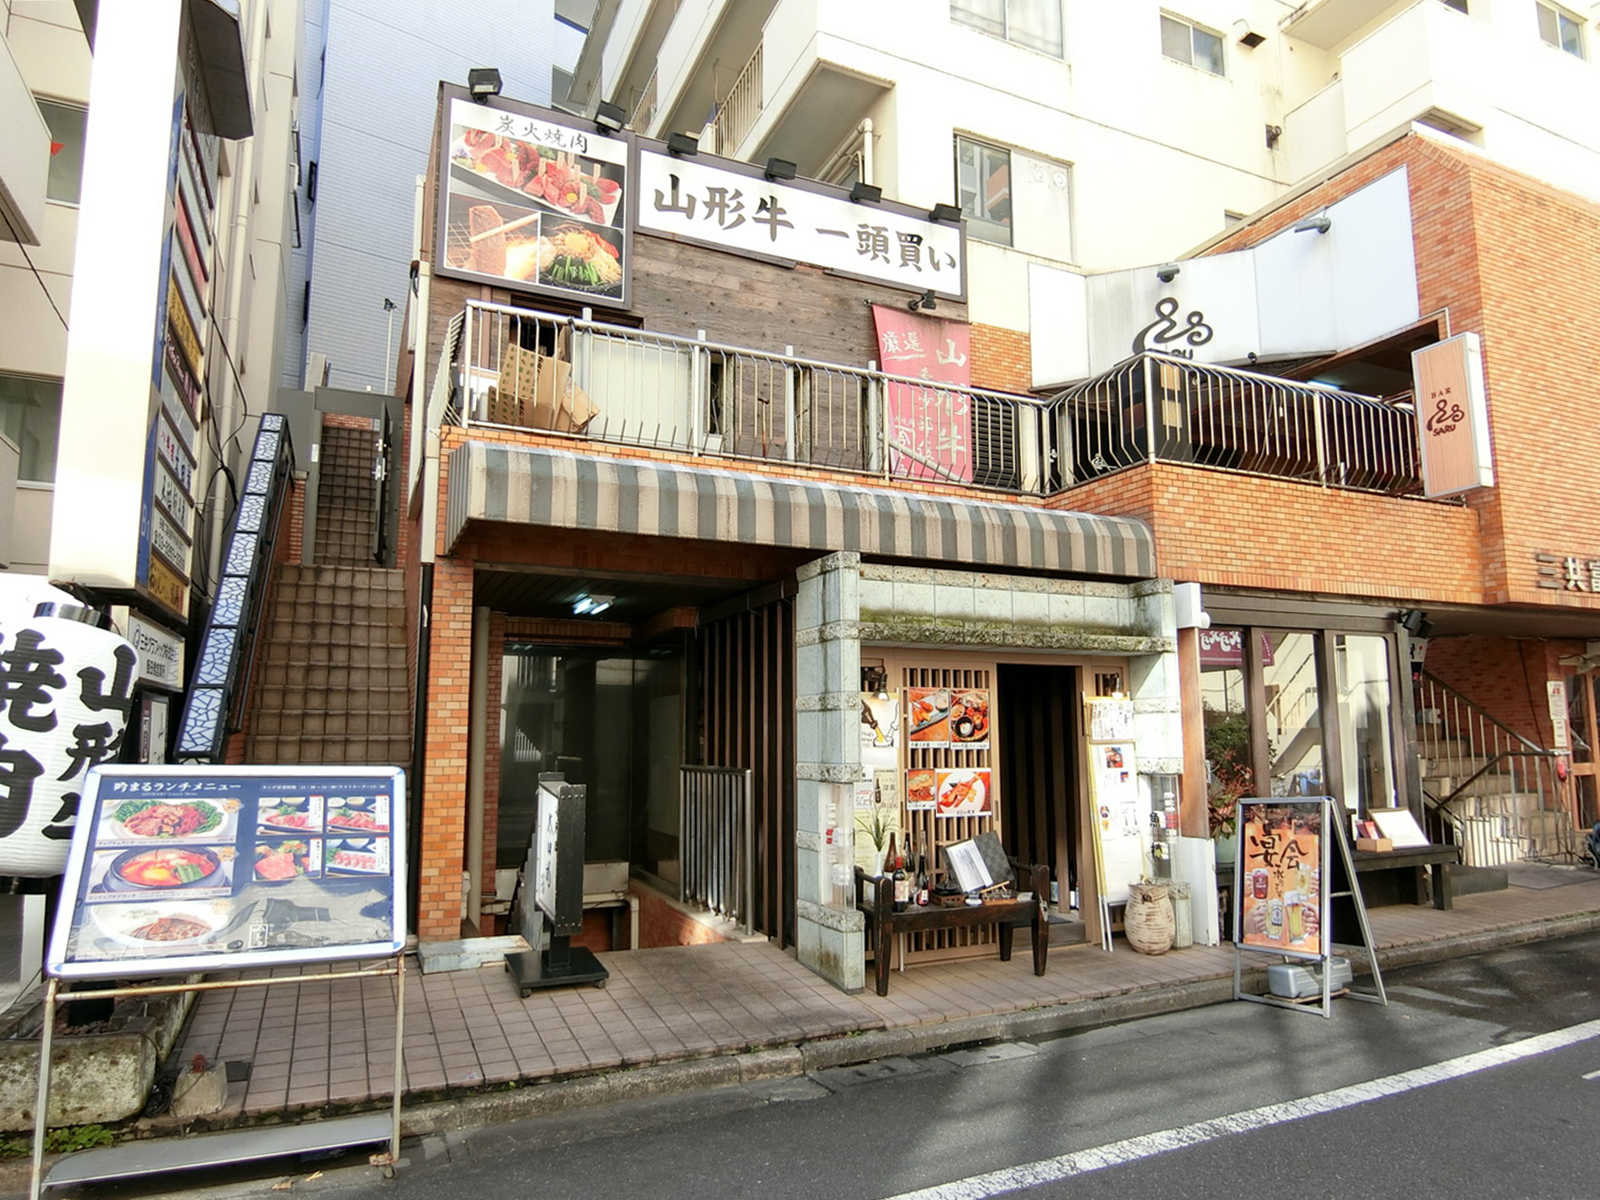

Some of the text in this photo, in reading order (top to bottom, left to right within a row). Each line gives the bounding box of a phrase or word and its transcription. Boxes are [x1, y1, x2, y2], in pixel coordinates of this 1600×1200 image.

[495, 114, 588, 154] 炭火焼肉
[653, 173, 957, 272] 山形牛 一頭買い
[881, 330, 925, 354] 厳選
[1431, 387, 1452, 400] BAR
[1432, 423, 1457, 437] SARU
[113, 781, 242, 793] 吟まるランチメニュー
[1249, 822, 1310, 871] 宴会
